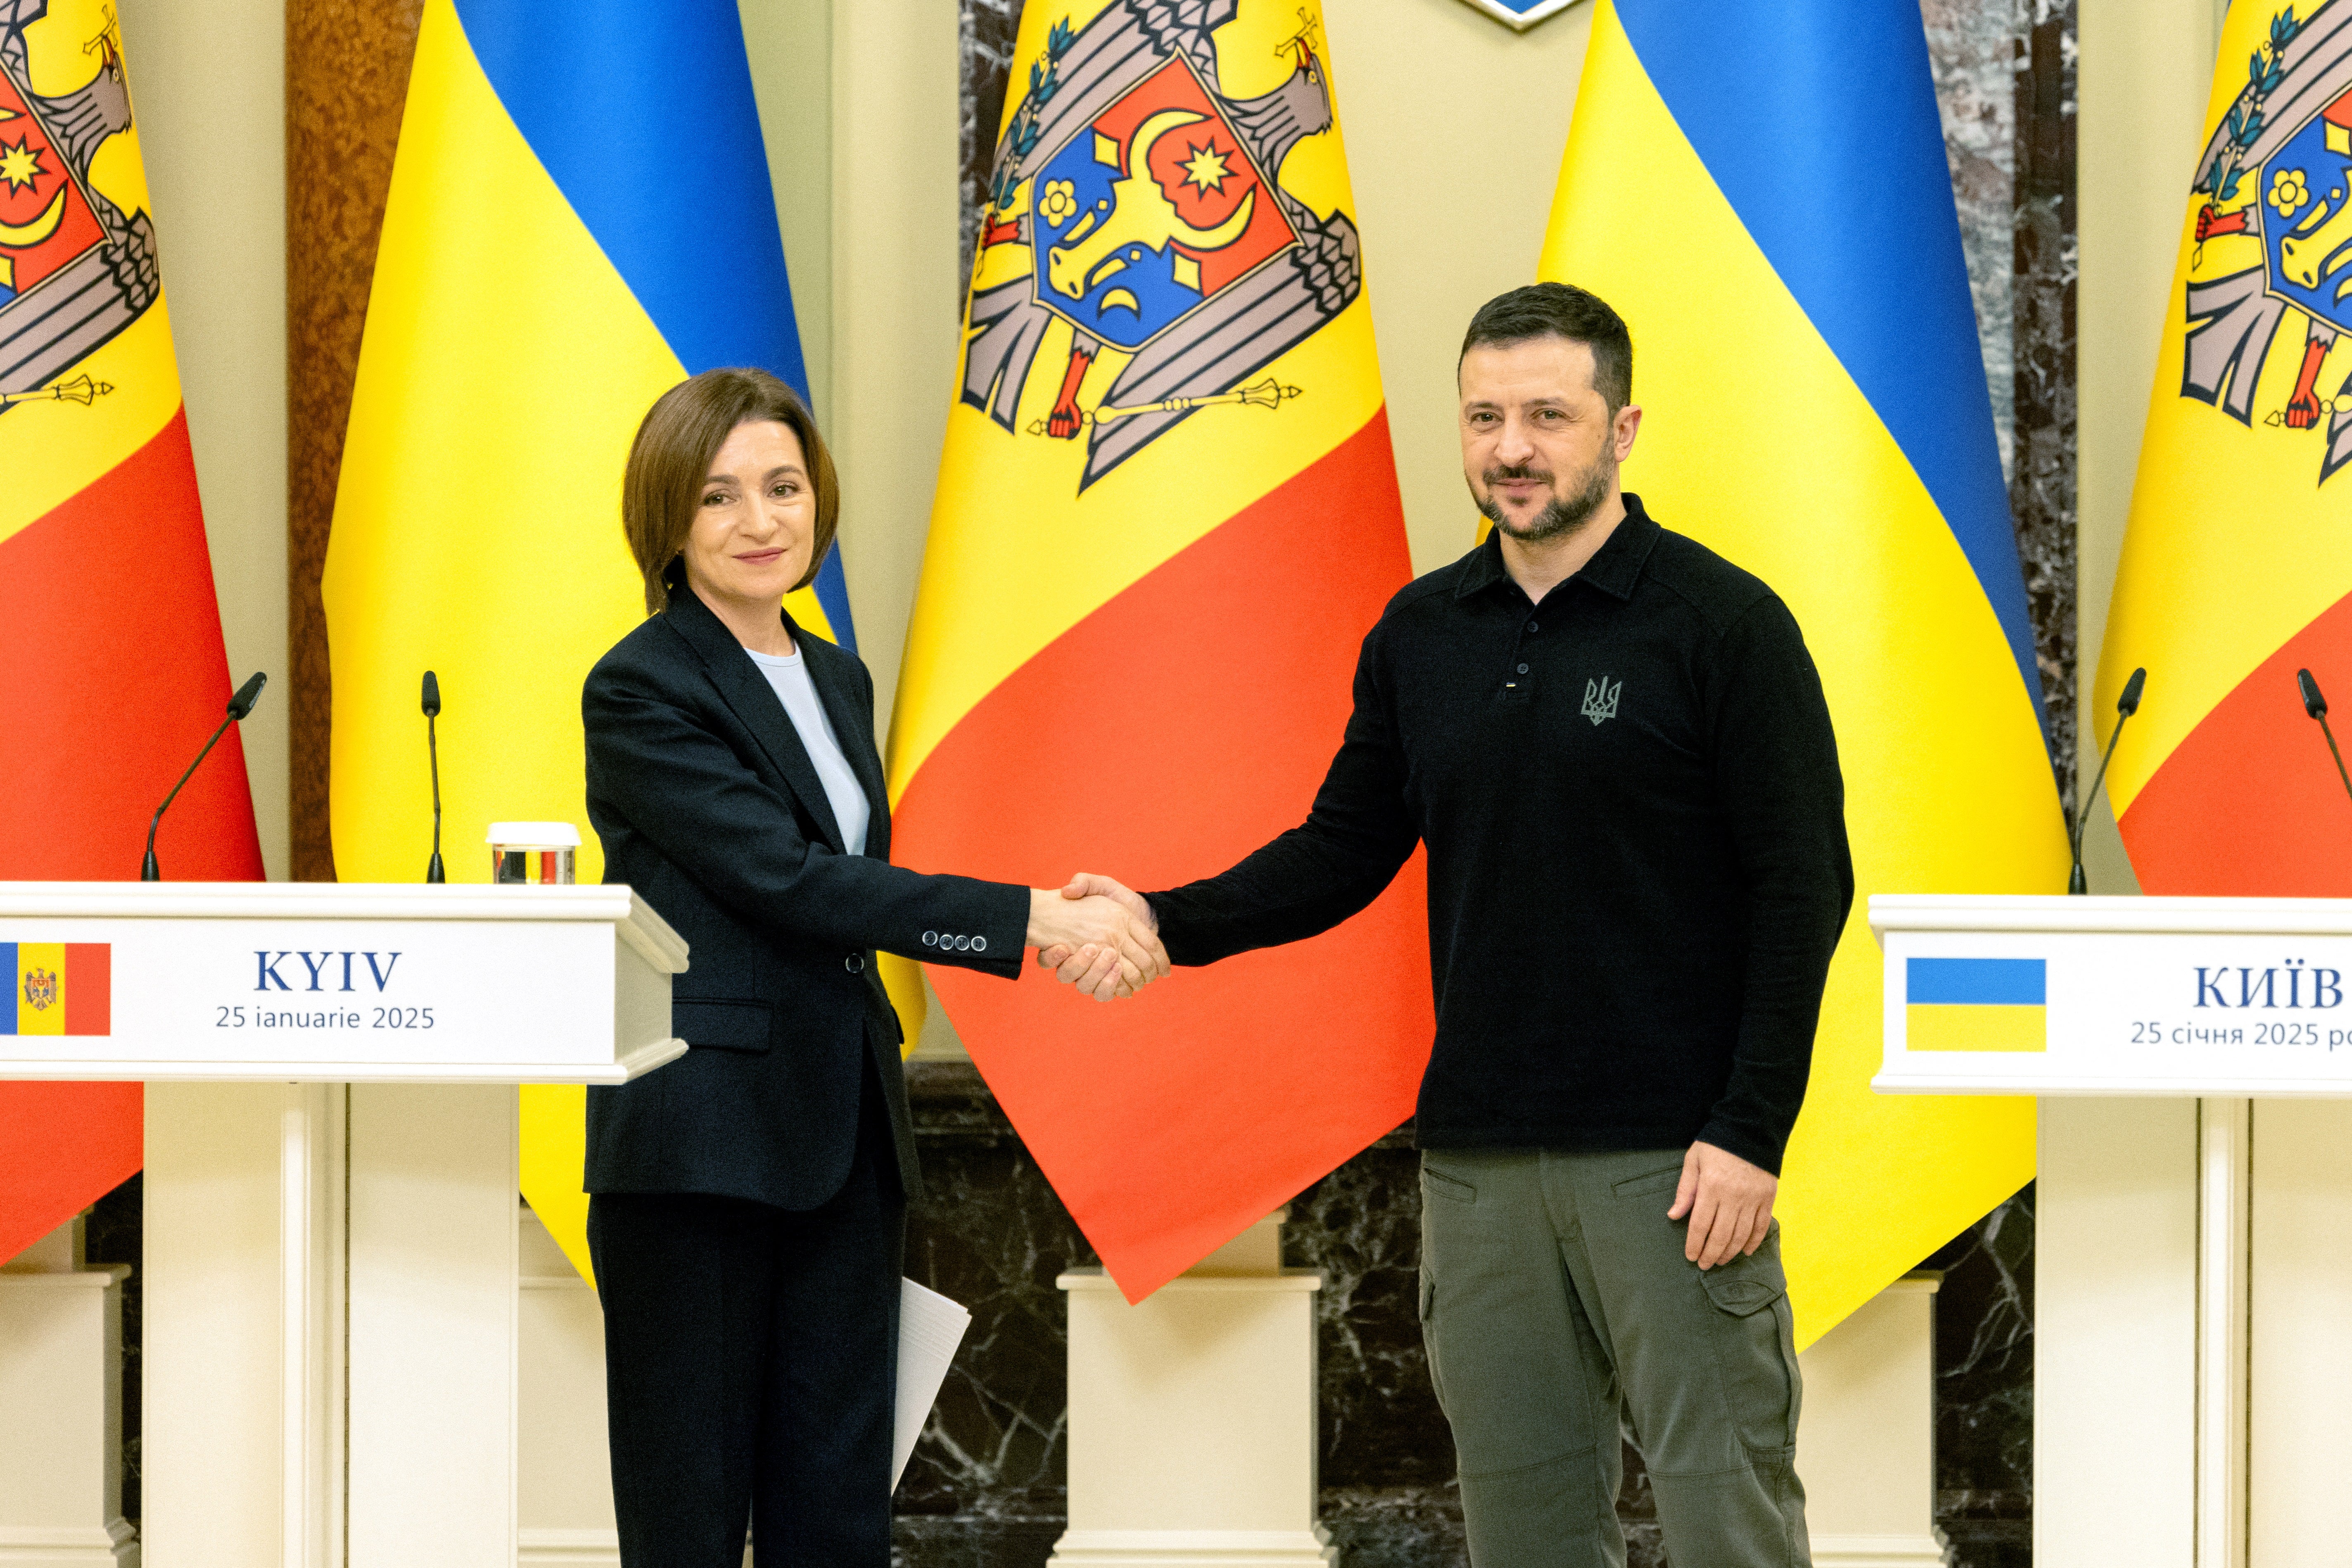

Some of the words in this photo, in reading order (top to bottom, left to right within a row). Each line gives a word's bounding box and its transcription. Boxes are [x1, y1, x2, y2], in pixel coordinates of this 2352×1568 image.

[254, 951, 402, 992] KYIV
[2194, 958, 2343, 1009] КИЇВ
[216, 1006, 245, 1028] 25
[256, 1006, 361, 1029] ianuarie
[373, 1007, 434, 1029] 2025
[2131, 1021, 2162, 1044] 25
[2172, 1021, 2243, 1044] січня
[2254, 1022, 2319, 1046] 2025
